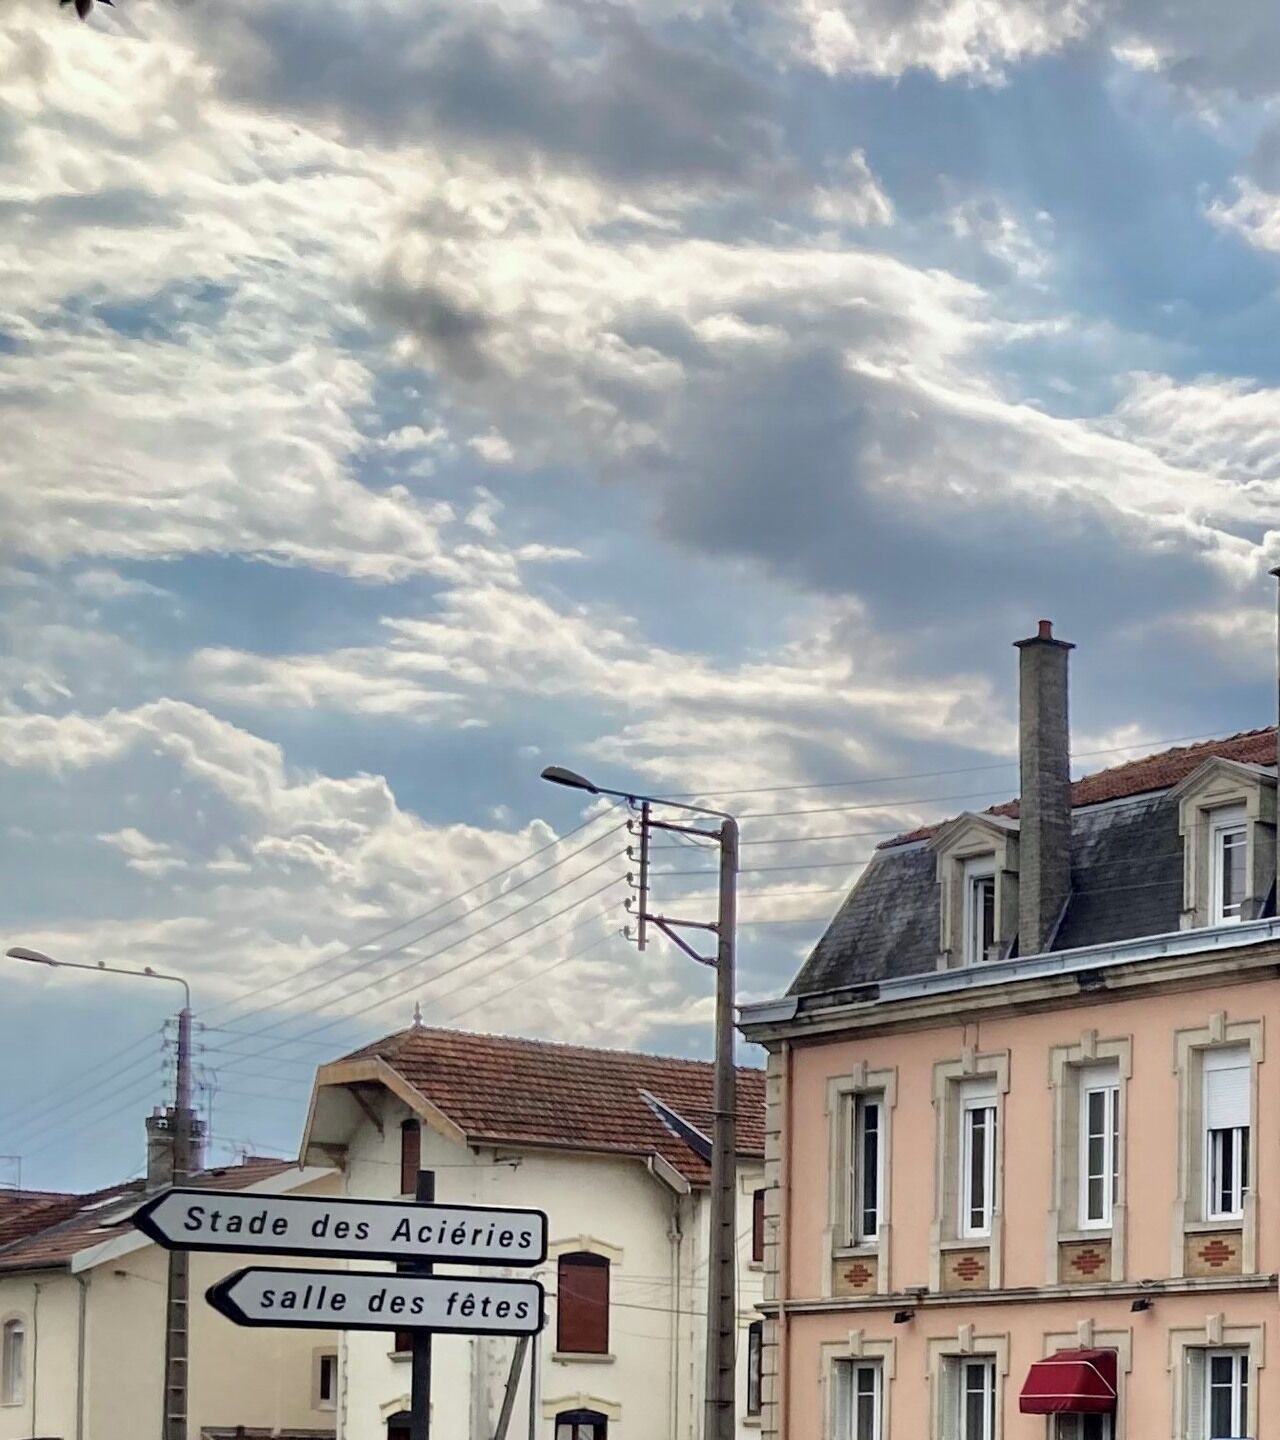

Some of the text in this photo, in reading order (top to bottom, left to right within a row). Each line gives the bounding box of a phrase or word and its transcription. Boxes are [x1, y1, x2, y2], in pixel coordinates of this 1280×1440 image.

[183, 1206, 533, 1249] Stade des Aciéries
[260, 1285, 531, 1320] salle des fêtes
